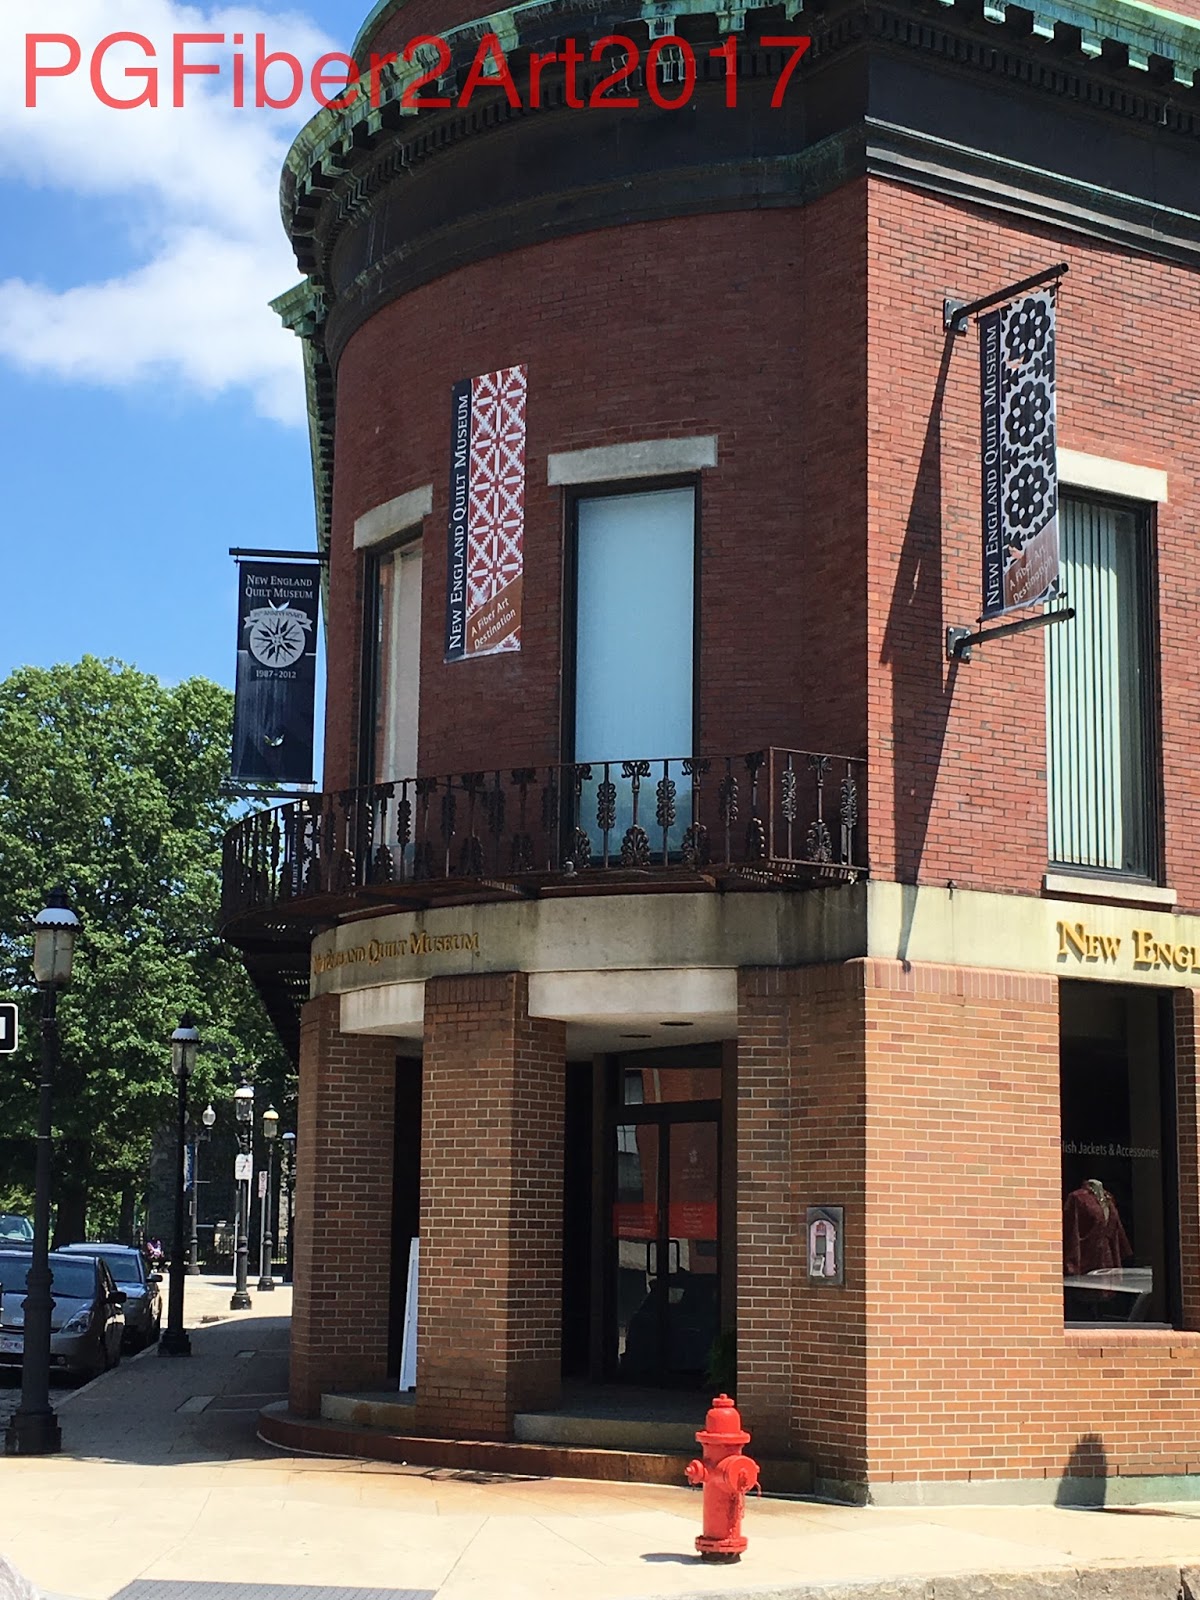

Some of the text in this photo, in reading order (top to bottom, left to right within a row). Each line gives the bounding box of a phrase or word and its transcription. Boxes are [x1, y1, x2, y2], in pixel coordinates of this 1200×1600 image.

[984, 325, 1000, 607] NEW ENGLAND QUILT MUSEUM
[449, 394, 469, 650] NEW ENGLAND QUILT MUSEUM
[245, 586, 314, 599] QUILT MUSEUM
[246, 574, 313, 587] NEW ENGLAND
[471, 597, 510, 637] A Fiber Art
[474, 608, 516, 650] Destination
[368, 939, 407, 966] QUILT
[410, 930, 479, 955] MUSEUM
[1056, 920, 1121, 961] NEW
[1079, 1142, 1107, 1156] Jackets
